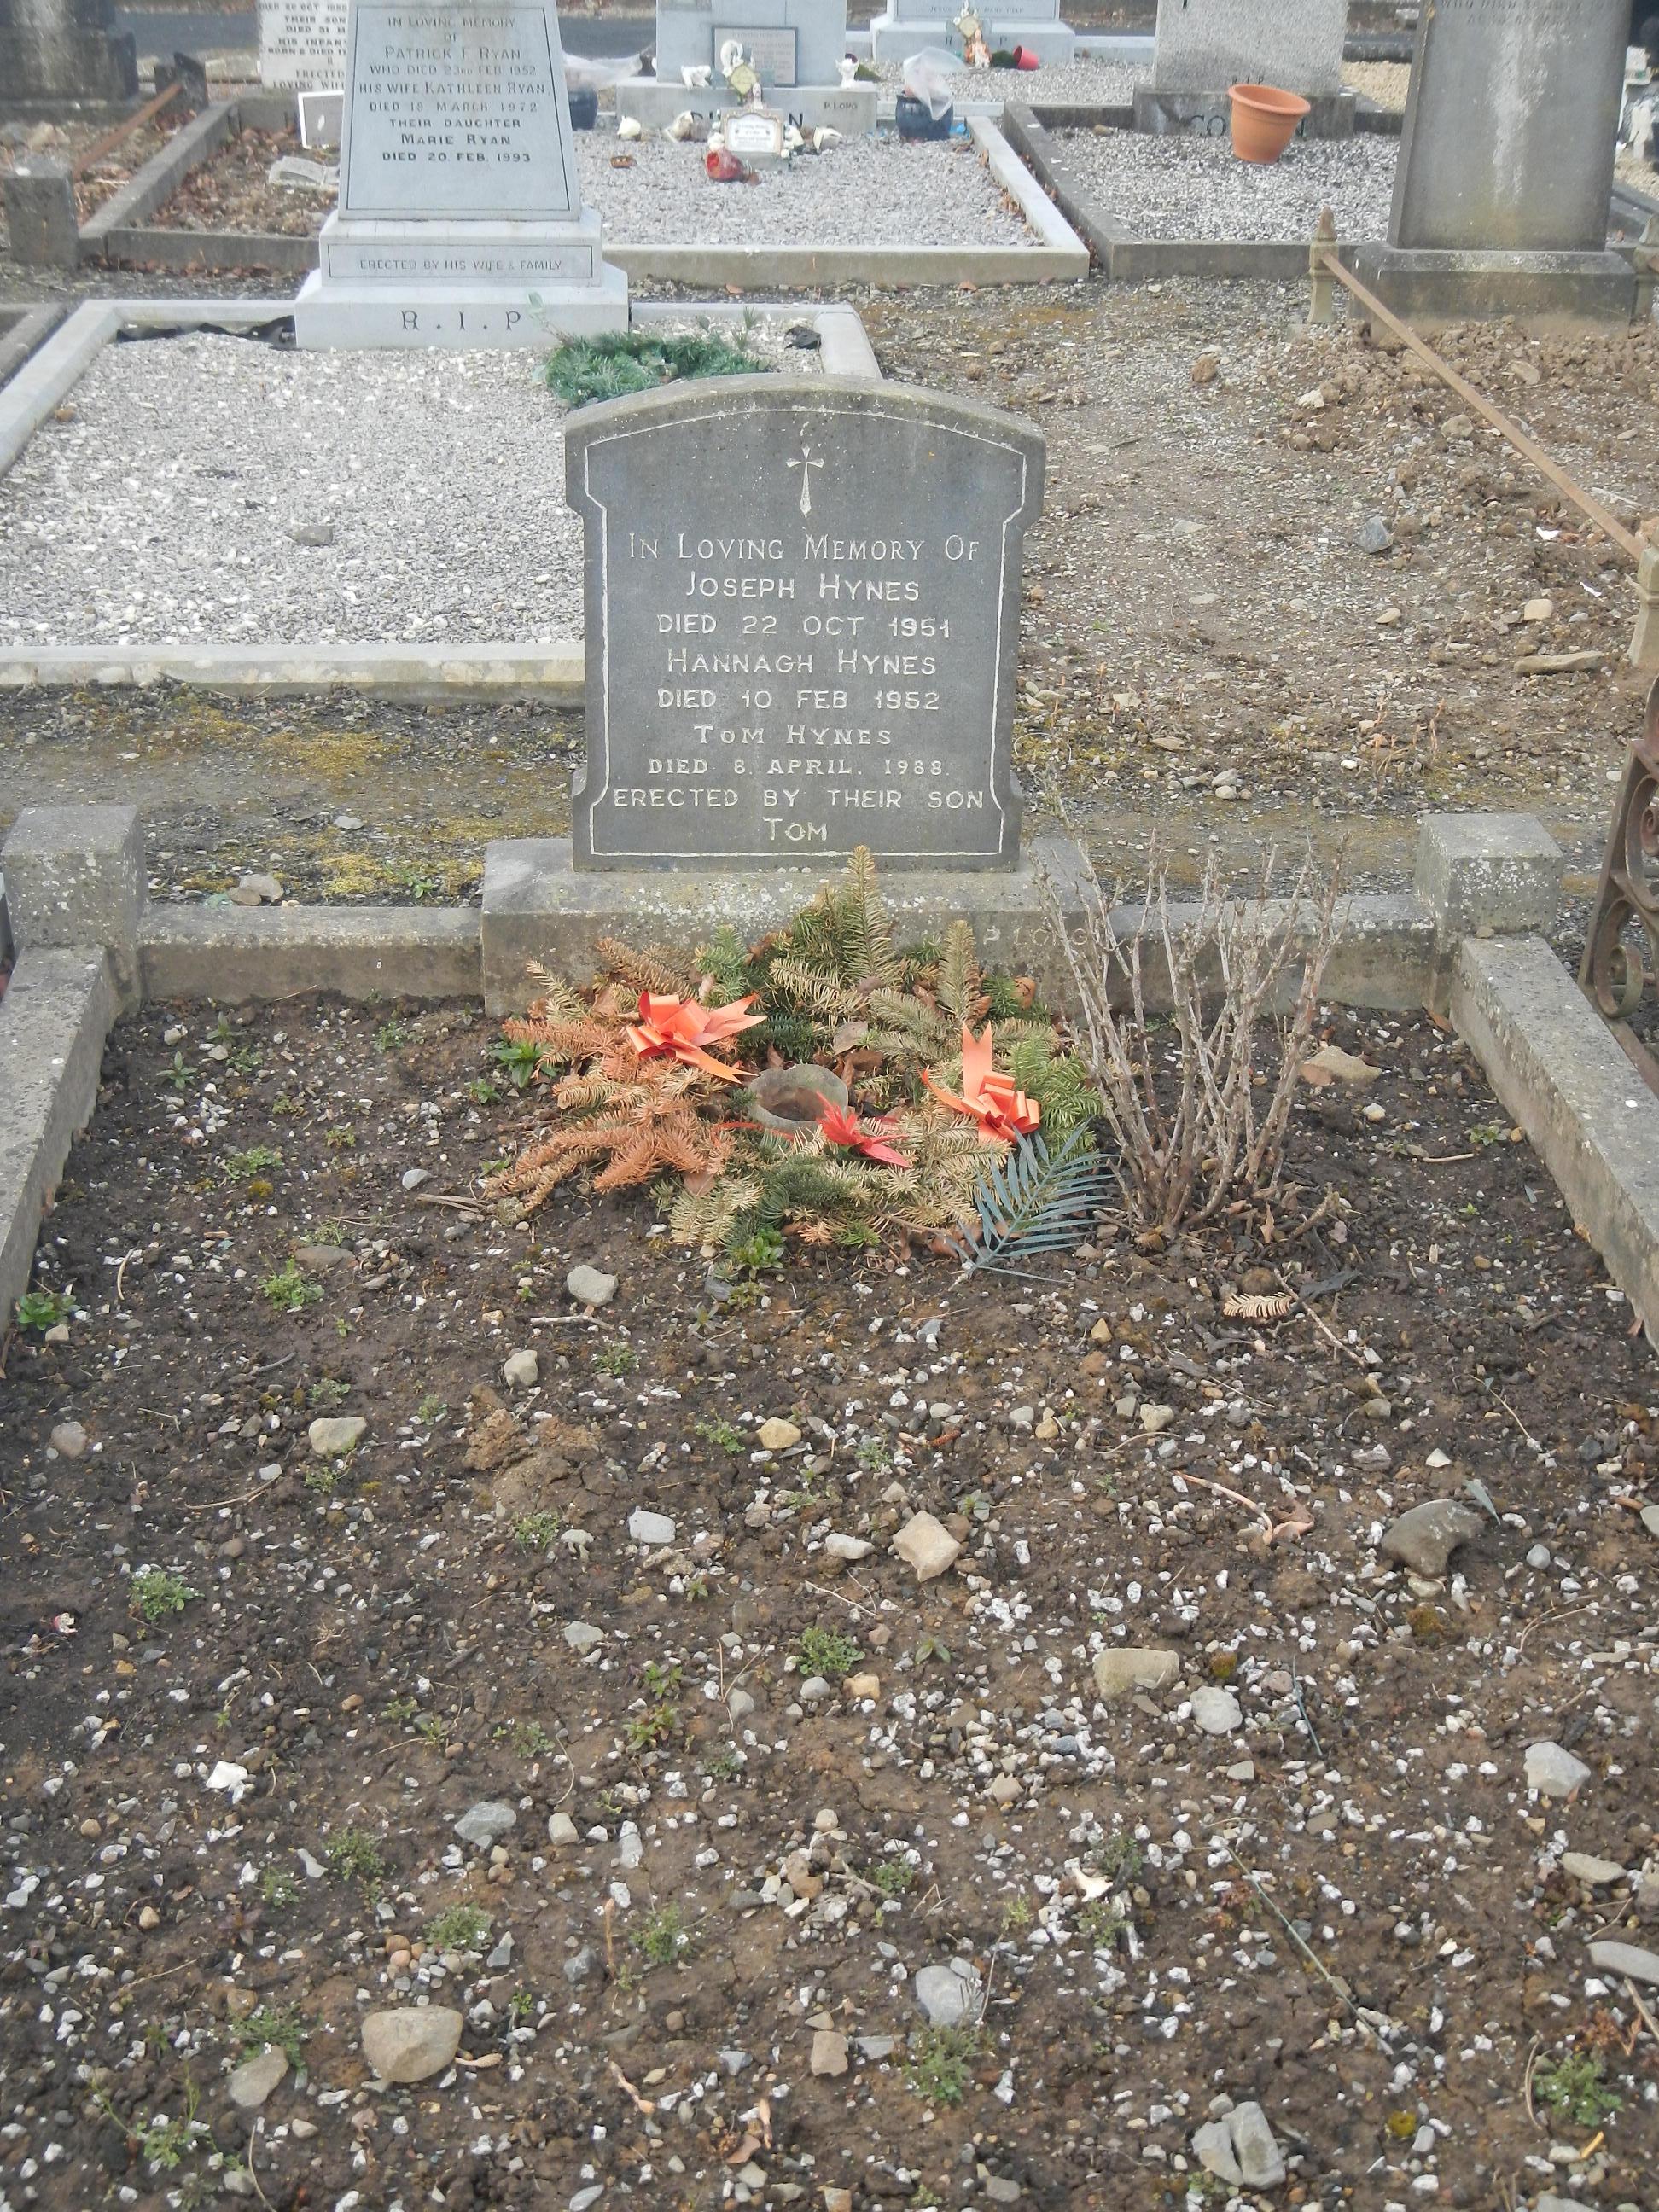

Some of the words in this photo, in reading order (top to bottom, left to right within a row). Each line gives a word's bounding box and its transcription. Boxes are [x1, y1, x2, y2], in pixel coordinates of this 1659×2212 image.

[388, 17, 402, 27] IN
[409, 17, 456, 28] LOVING
[463, 17, 516, 28] MEMORY
[444, 33, 457, 42] OF
[385, 46, 451, 59] PATRICK
[480, 46, 521, 60] RYAN
[295, 70, 345, 79] ERECTED
[370, 65, 399, 75] WHO
[407, 65, 437, 75] DIED
[510, 66, 537, 75] 1952
[273, 80, 313, 90] LOVING
[359, 82, 382, 94] HIS
[387, 82, 418, 94] WIFE
[425, 80, 502, 94] KATHLEEN
[370, 102, 399, 112] DIED
[410, 102, 423, 112] 19
[436, 102, 488, 112] MARCH
[501, 102, 538, 112] 1972
[389, 119, 431, 127] THEIR
[444, 119, 521, 127] DAUGHTER
[401, 133, 455, 144] MARIE
[467, 133, 511, 145] RYAN
[382, 152, 416, 161] DIED
[497, 153, 531, 162] 1993
[359, 259, 417, 270] ERECTED
[423, 259, 439, 270] BY
[445, 259, 467, 270] HIS
[473, 259, 504, 271] WIFE
[520, 259, 562, 271] FAMILY
[628, 532, 659, 559] IN
[678, 532, 785, 560] LOVING
[803, 533, 926, 561] MEMORY
[945, 534, 980, 561] OF
[685, 570, 795, 599] JOSEPH
[819, 573, 920, 602] HYNES
[656, 613, 717, 634] DIED
[742, 615, 777, 635] 22
[803, 615, 865, 637] OCT
[888, 616, 951, 639] 1951
[667, 648, 813, 673] HANNAGH
[838, 649, 937, 676] HYNES
[657, 688, 717, 709] DIED
[742, 690, 772, 709] 10
[796, 690, 848, 710] FEB
[874, 690, 940, 711] 1952
[693, 724, 765, 744] TOM
[786, 725, 892, 745] HYNES
[648, 758, 708, 774] DIED
[767, 759, 863, 776] APRIL.
[884, 759, 951, 776] 1988.
[613, 788, 739, 807] ERECTED
[763, 789, 800, 807] BY
[827, 789, 903, 809] THEIR
[927, 790, 983, 809] SON
[762, 816, 828, 841] TOM
